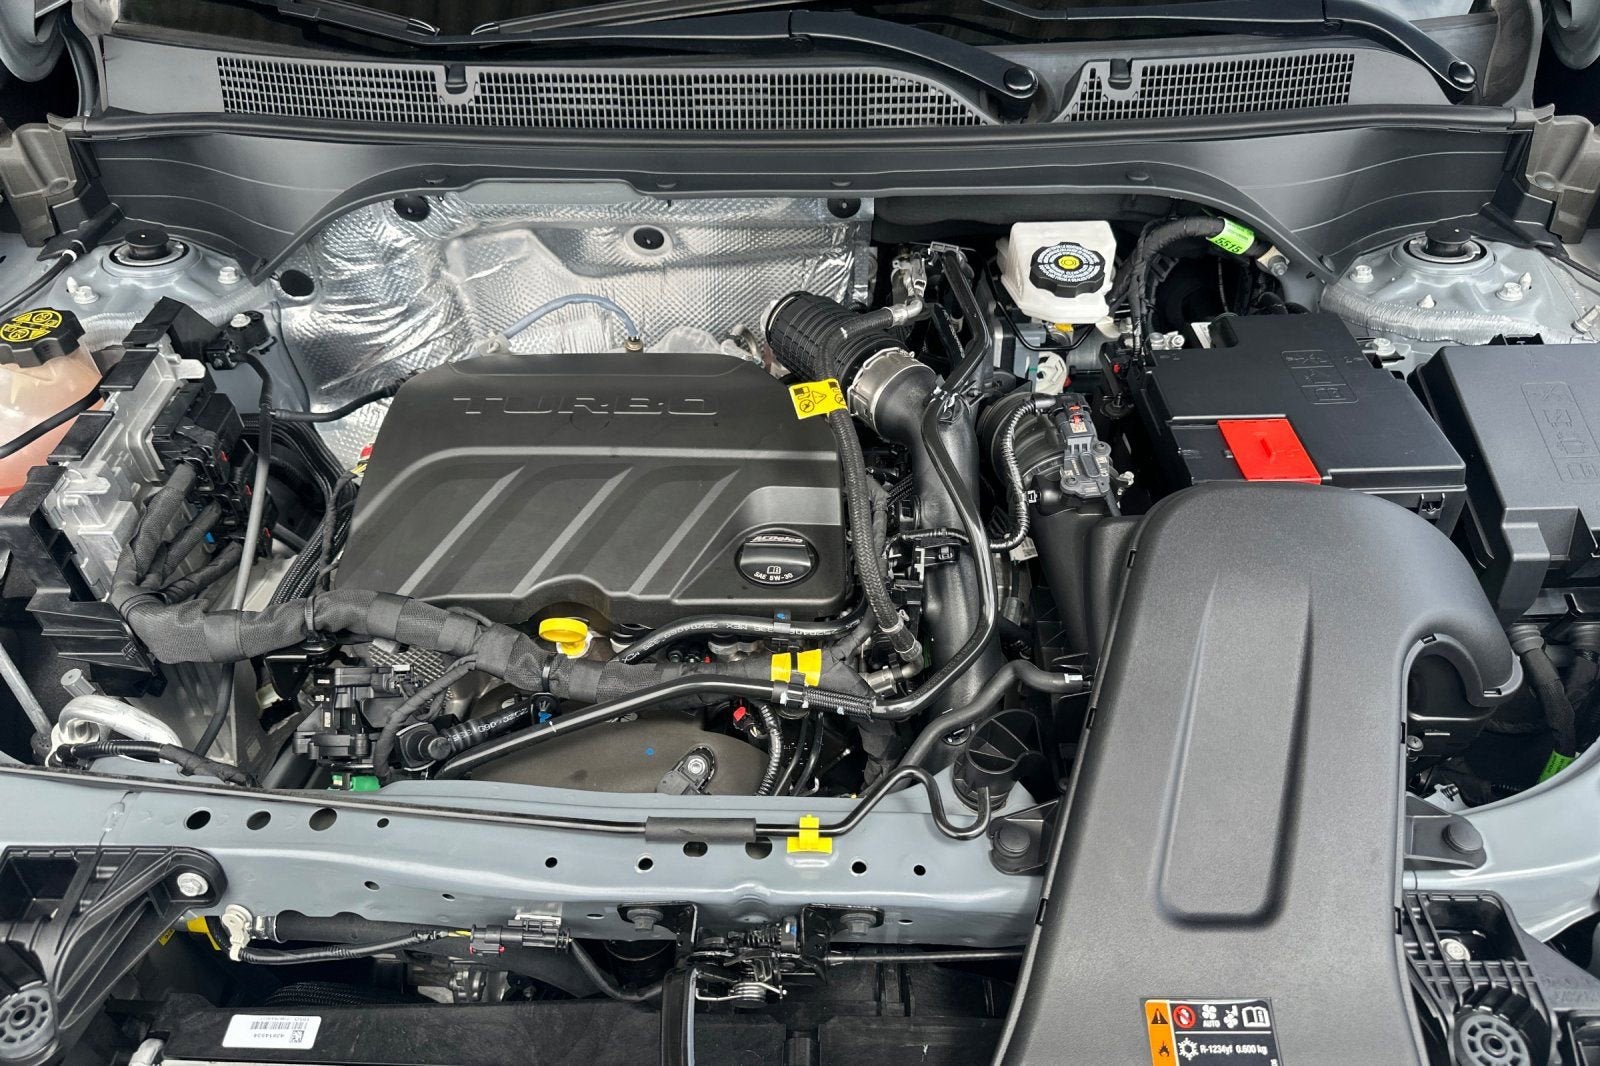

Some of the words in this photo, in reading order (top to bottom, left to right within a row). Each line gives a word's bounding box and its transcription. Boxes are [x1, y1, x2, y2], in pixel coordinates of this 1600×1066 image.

[1215, 237, 1243, 253] 5515
[452, 397, 718, 416] TURBO
[749, 535, 803, 543] ACDelco
[754, 571, 768, 580] SAE
[769, 572, 794, 581] 5W-30
[1202, 1020, 1220, 1028] AUTO
[1199, 1044, 1233, 1055] R-1234yf
[1257, 1045, 1268, 1055] kg
